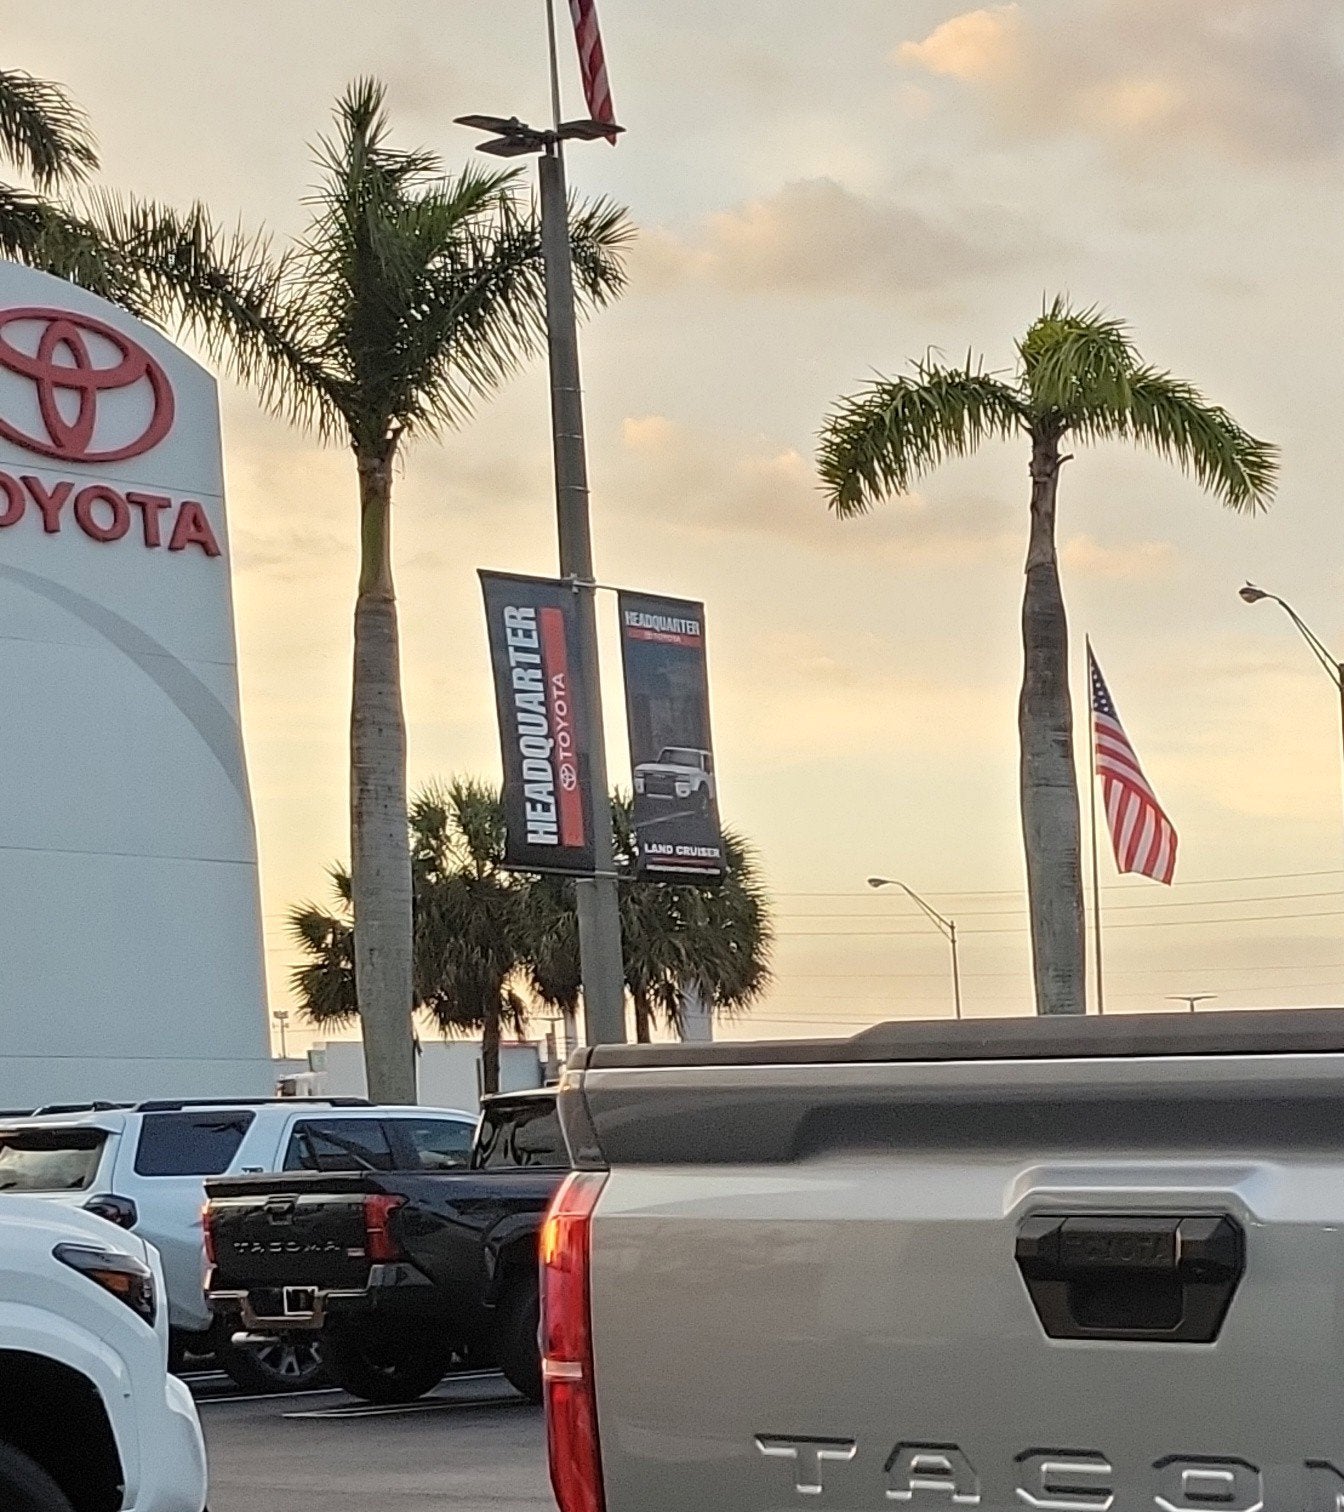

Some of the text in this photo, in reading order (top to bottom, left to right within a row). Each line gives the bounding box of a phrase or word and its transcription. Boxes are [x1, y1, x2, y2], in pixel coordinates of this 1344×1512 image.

[624, 610, 700, 636] HEADQUARTER
[503, 605, 560, 846] HEADQUARTER
[551, 672, 573, 761] TOYOTA
[644, 842, 721, 859] LAND CRUISER
[234, 1240, 341, 1254] TACOMA
